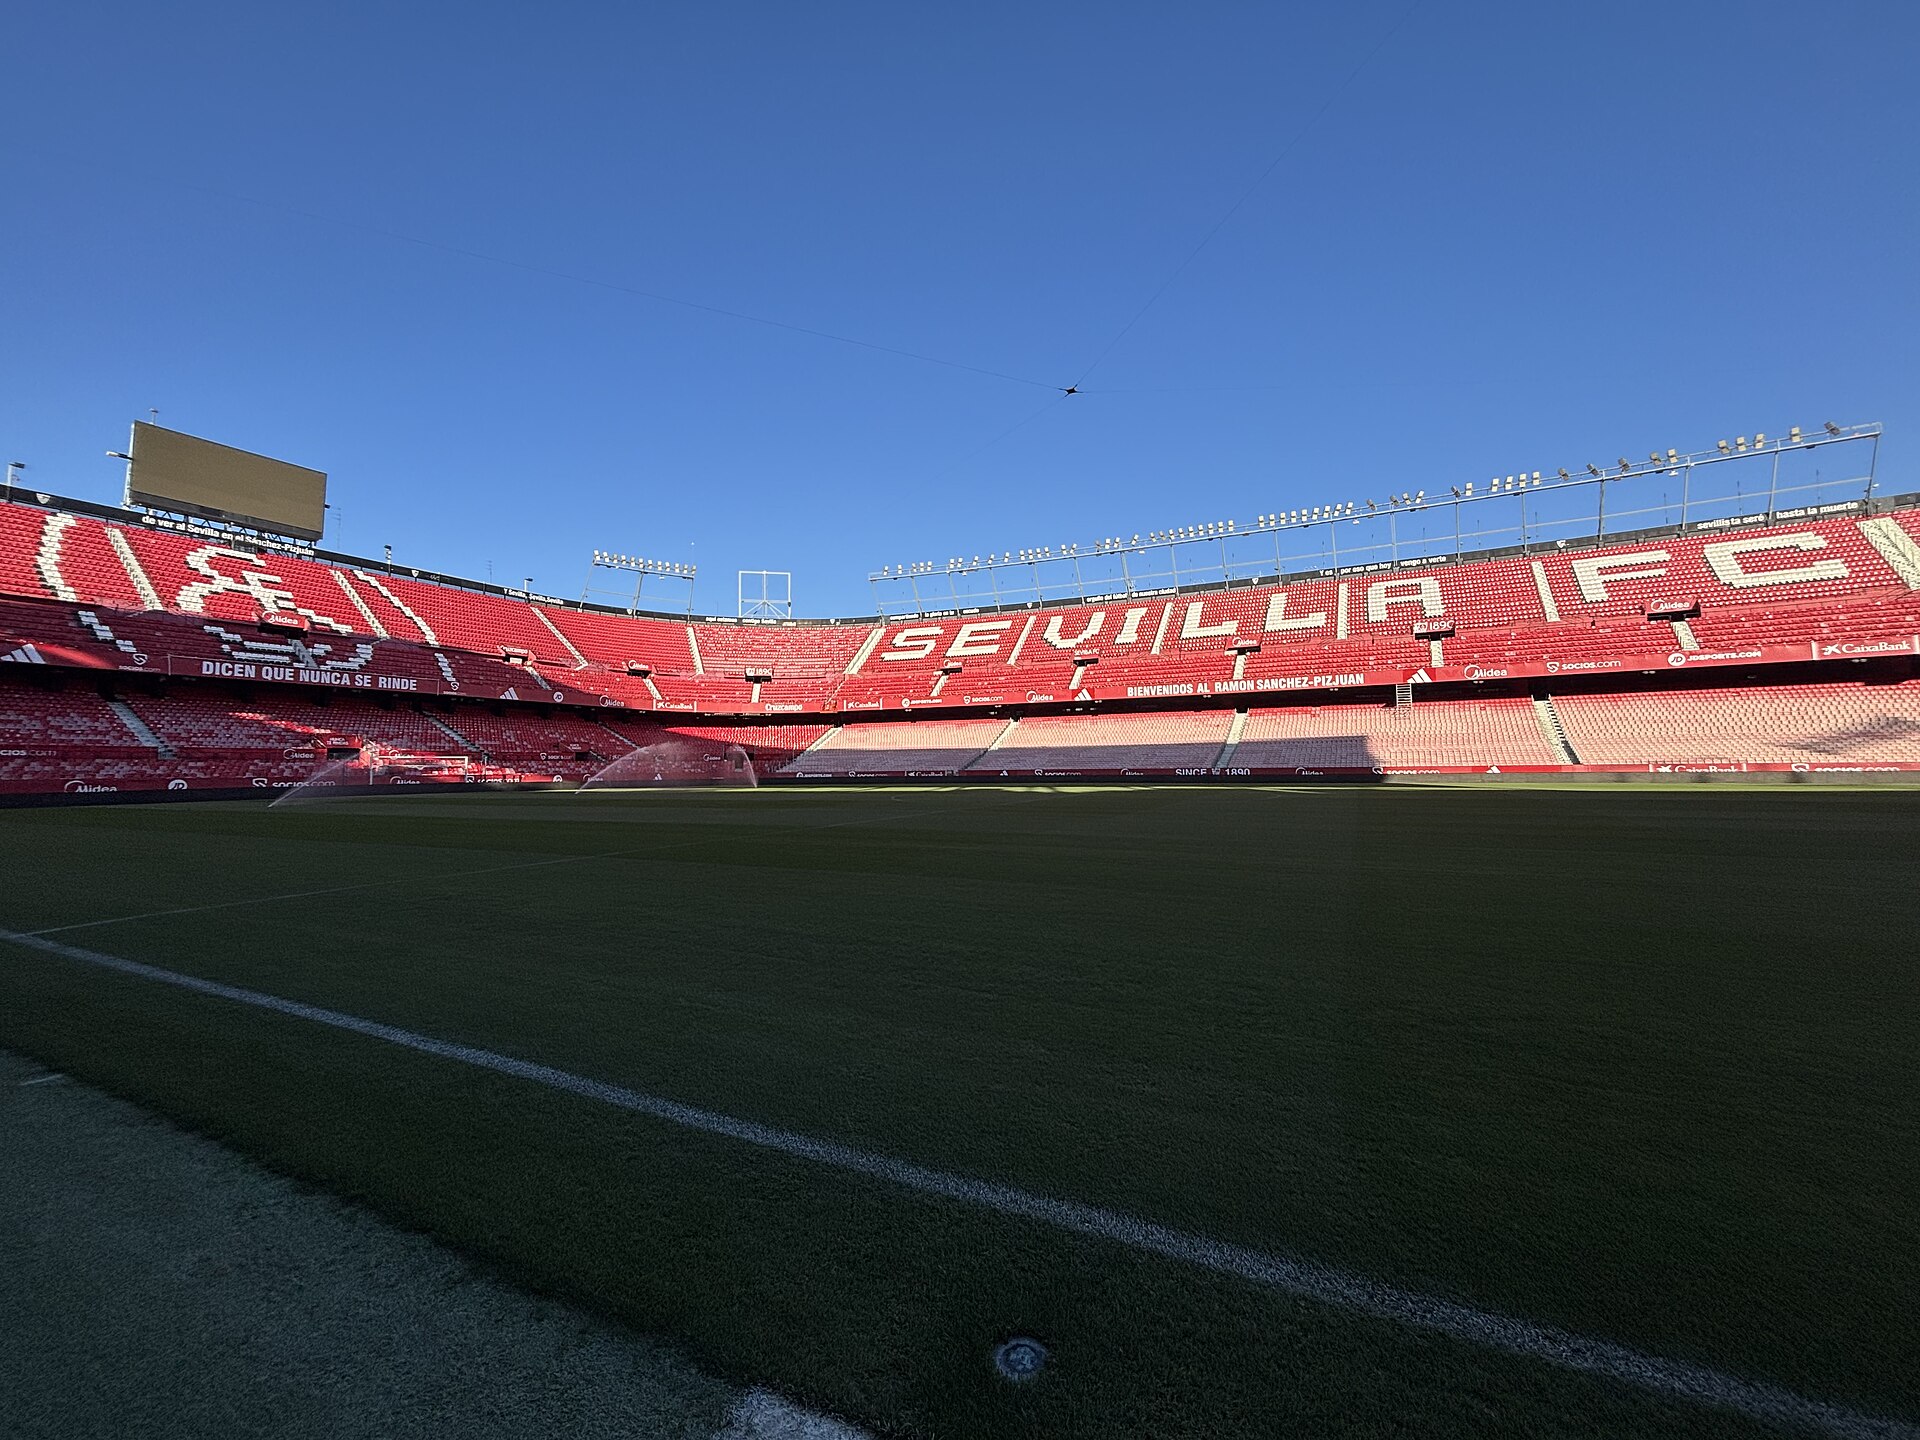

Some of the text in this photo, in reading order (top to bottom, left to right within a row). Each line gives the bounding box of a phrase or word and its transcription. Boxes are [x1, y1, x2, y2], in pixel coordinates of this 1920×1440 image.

[1697, 501, 1859, 530] sevillista seré hasta la muerte
[142, 515, 156, 525] de
[157, 518, 175, 528] ver
[176, 522, 186, 531] al
[187, 525, 220, 538] Sevilla
[221, 532, 234, 541] en
[1340, 567, 1352, 575] por
[1379, 561, 1392, 570] hoy
[1400, 558, 1421, 567] vengo
[1428, 555, 1446, 564] verte
[1656, 600, 1690, 611] Midea
[266, 613, 299, 625] Midea
[880, 576, 1444, 661] SEVILLA
[1841, 640, 1911, 653] CaixaBank
[1687, 651, 1762, 661] JDSPORTS.COM
[1561, 660, 1622, 671] socios.com
[202, 661, 417, 691] DICEN QUE NUNCA SE RINDE
[1470, 667, 1508, 679] Midea
[1127, 673, 1365, 697] BIENVENIDOS AL RAMON SANCHEZ-PIZJUAN
[603, 698, 625, 707] Midea
[1029, 693, 1054, 702] Midea
[664, 702, 693, 710] CaixaBank
